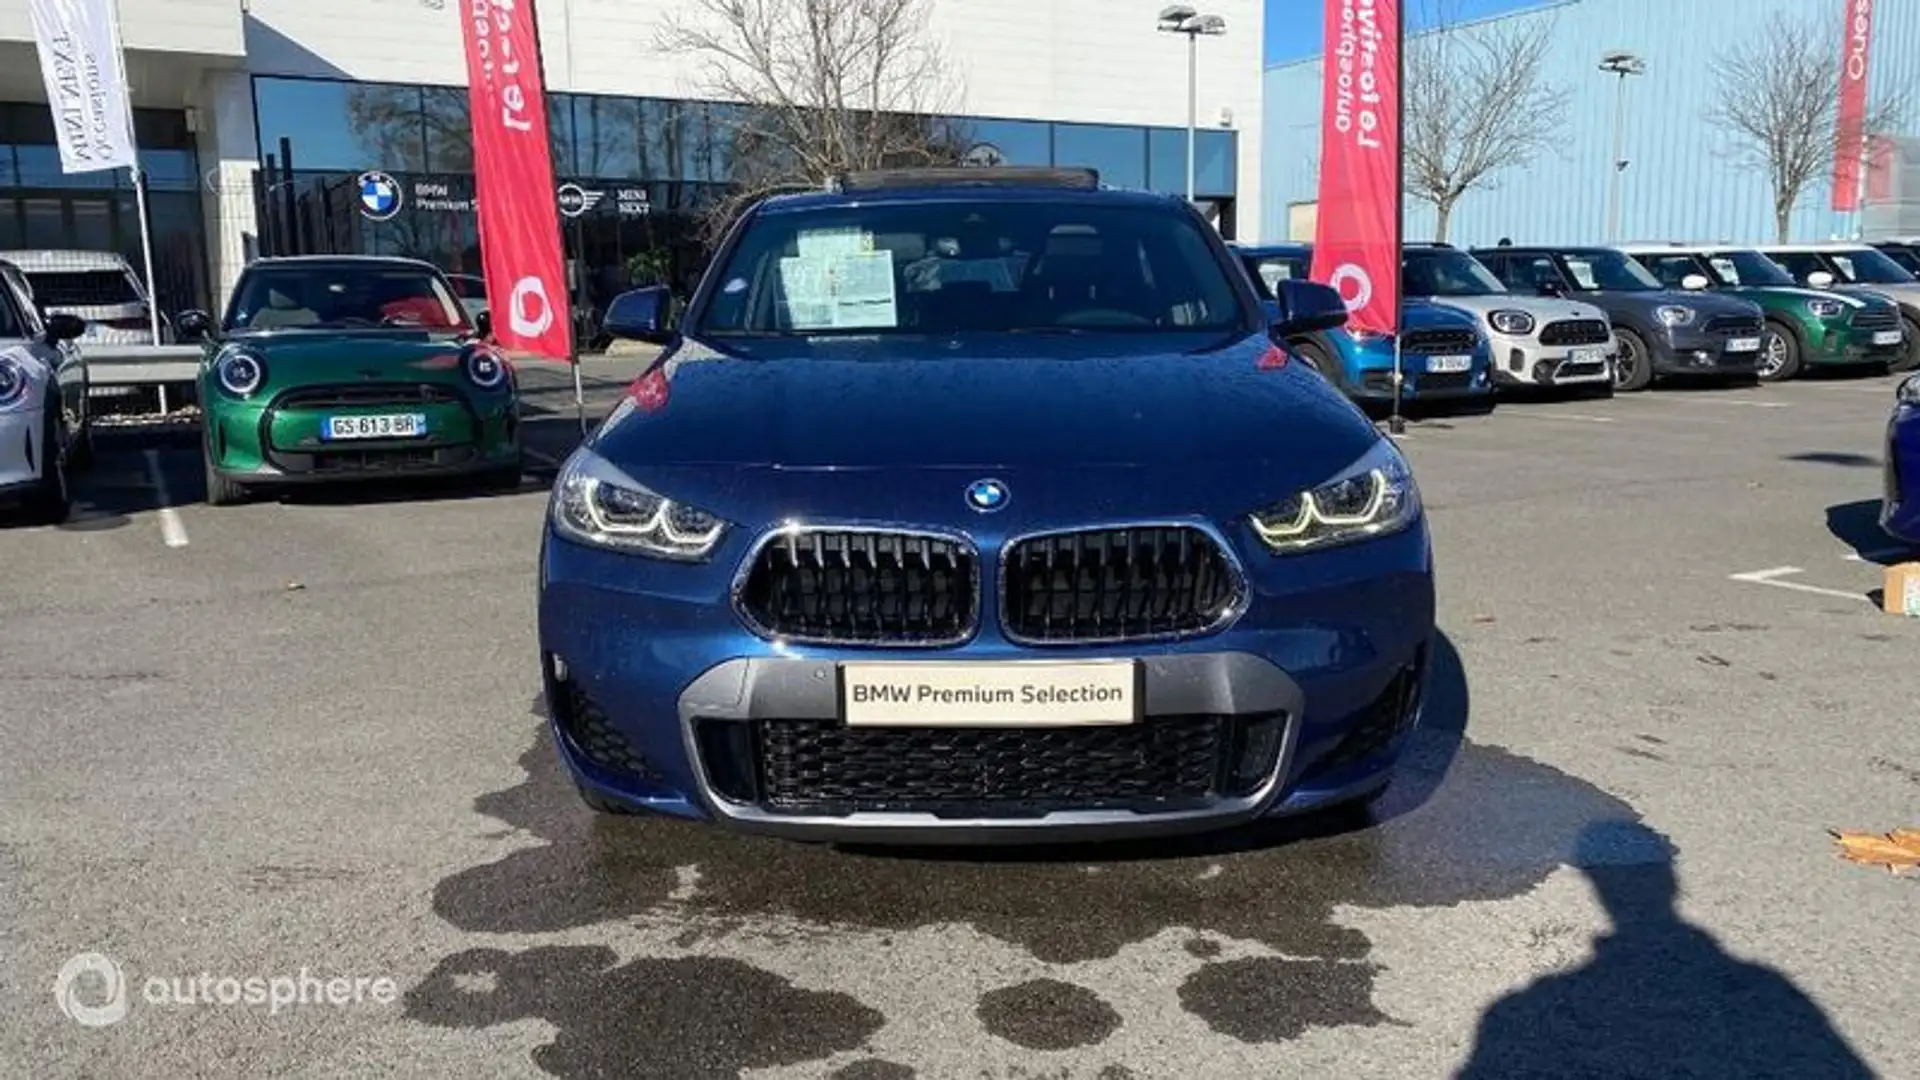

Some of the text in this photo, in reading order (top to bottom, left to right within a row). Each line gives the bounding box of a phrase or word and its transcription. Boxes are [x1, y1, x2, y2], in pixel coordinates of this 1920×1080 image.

[852, 683, 1123, 704] BMW Premium Selection
